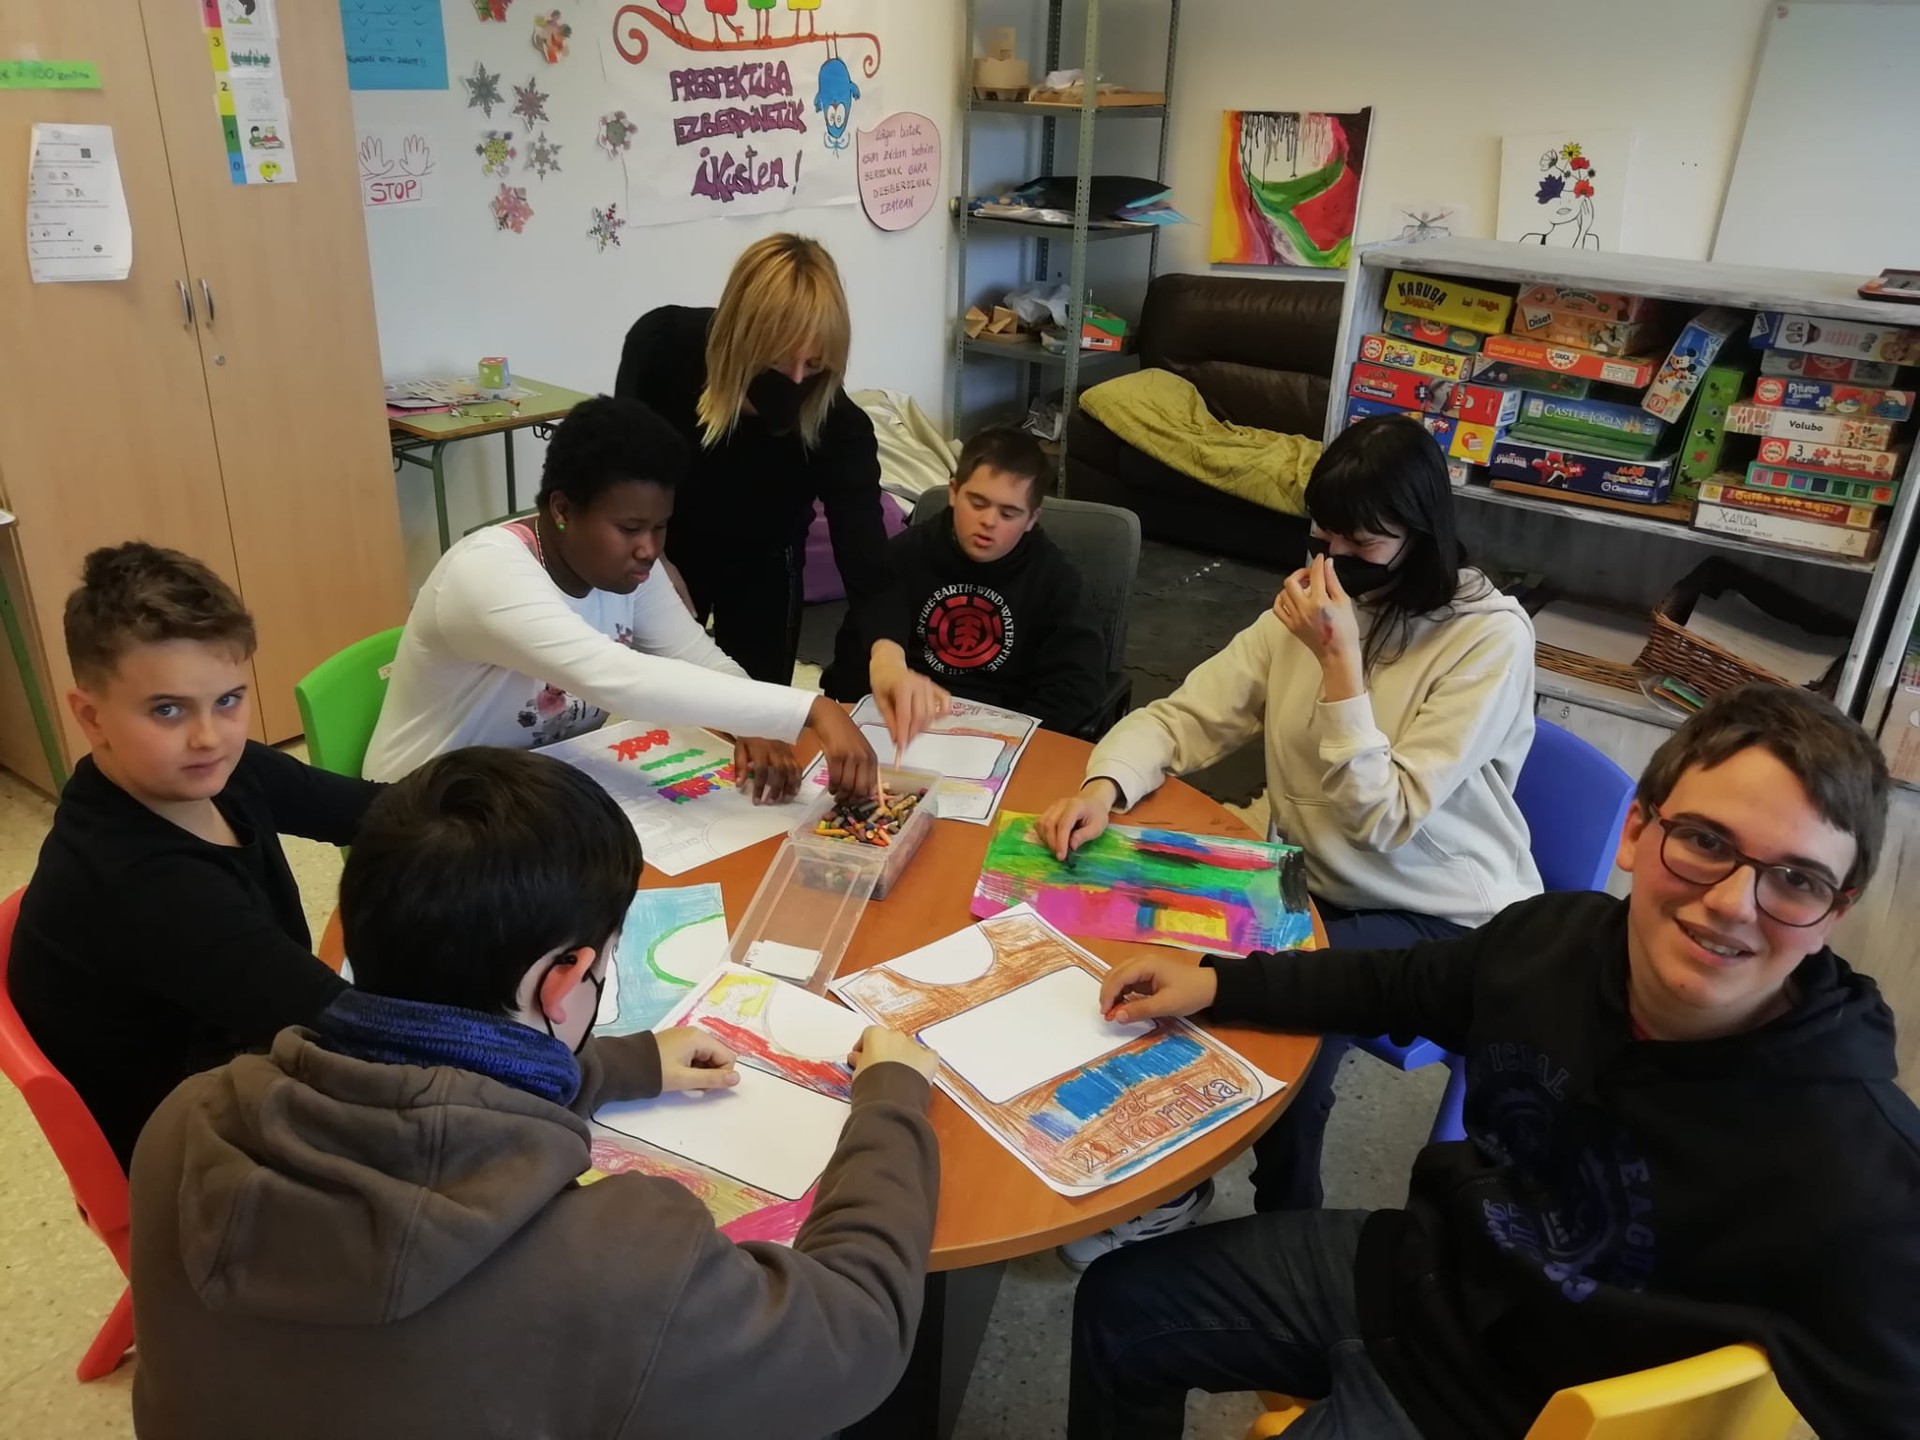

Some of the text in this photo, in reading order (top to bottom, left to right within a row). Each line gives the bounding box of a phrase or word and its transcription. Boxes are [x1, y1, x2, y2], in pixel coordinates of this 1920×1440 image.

[213, 37, 221, 47] 3
[221, 82, 229, 92] 2
[369, 179, 418, 203] STOP
[1397, 281, 1448, 307] KARUBA
[1528, 313, 1552, 329] Diset
[1789, 420, 1824, 432] Volubo
[1796, 444, 1804, 457] 3
[934, 583, 973, 601] EARTH
[977, 585, 1005, 606] WIND
[1000, 604, 1015, 646] WATER
[990, 649, 1011, 672] FIRE
[1110, 1078, 1243, 1150] korrika
[1113, 1087, 1153, 1124] aek
